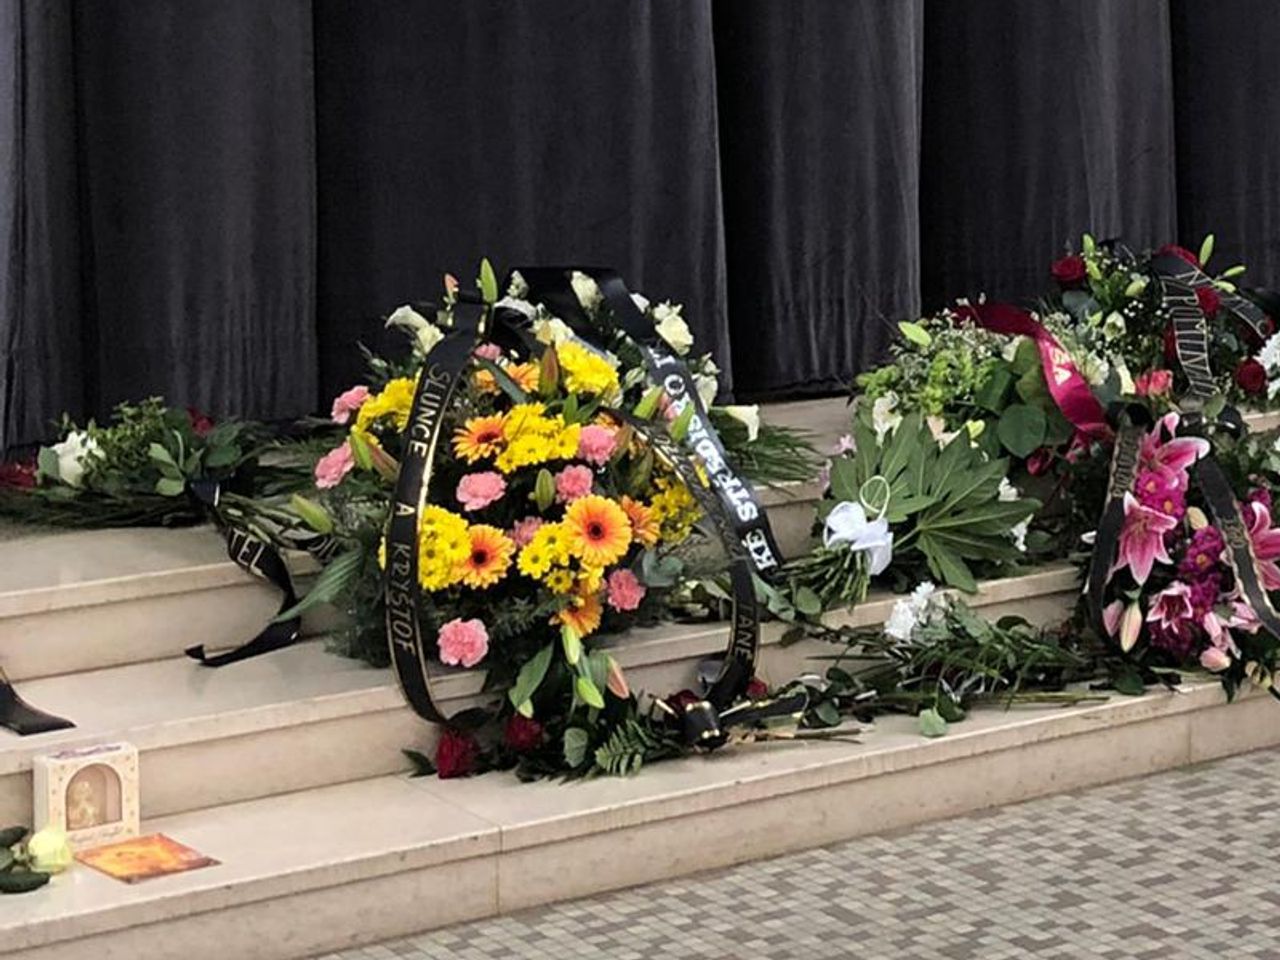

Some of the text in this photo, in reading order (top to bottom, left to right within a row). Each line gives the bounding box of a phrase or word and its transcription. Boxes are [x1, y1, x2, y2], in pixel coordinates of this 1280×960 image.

[390, 363, 450, 656] SLUNCE A KRYŠTOF
